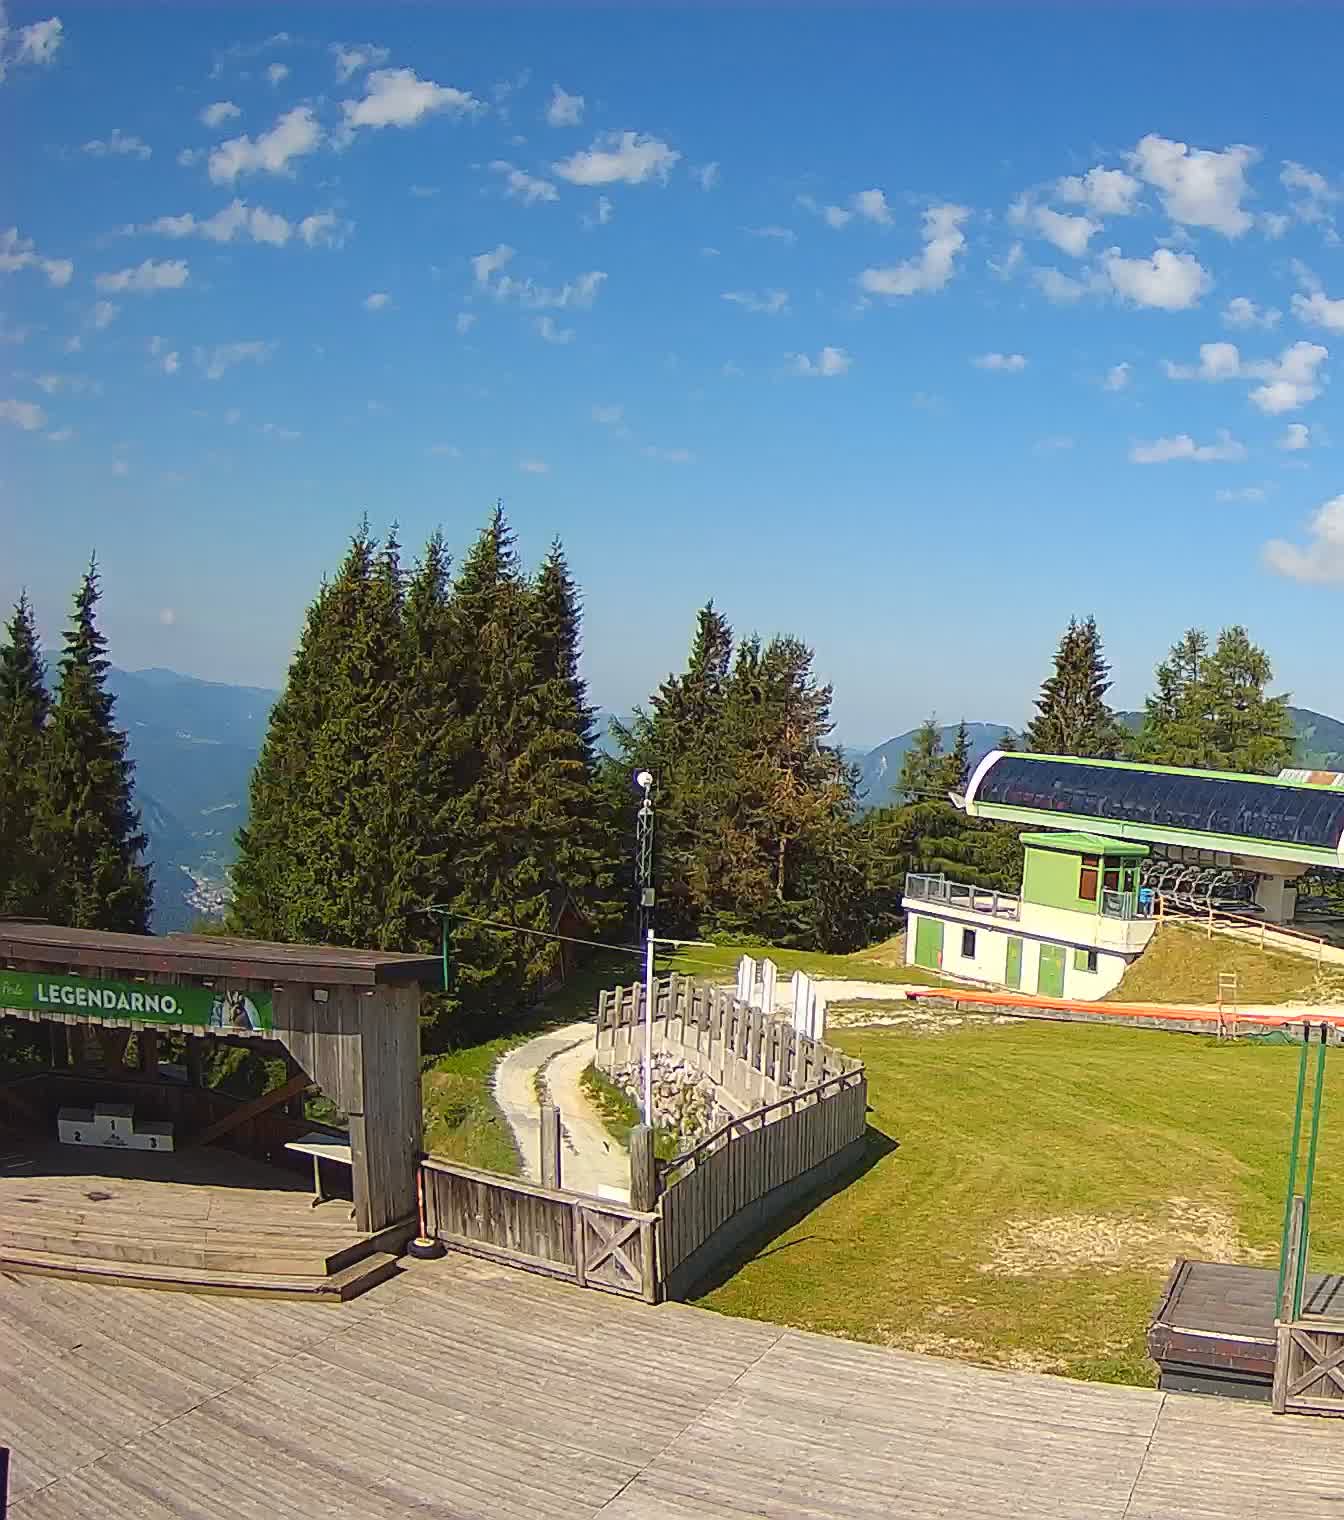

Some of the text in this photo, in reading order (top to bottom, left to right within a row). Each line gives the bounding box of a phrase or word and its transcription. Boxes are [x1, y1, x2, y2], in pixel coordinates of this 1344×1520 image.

[38, 983, 183, 1016] LEGENDARNO.
[110, 1119, 116, 1131] 1
[73, 1130, 82, 1142] 2
[149, 1136, 157, 1149] 3
